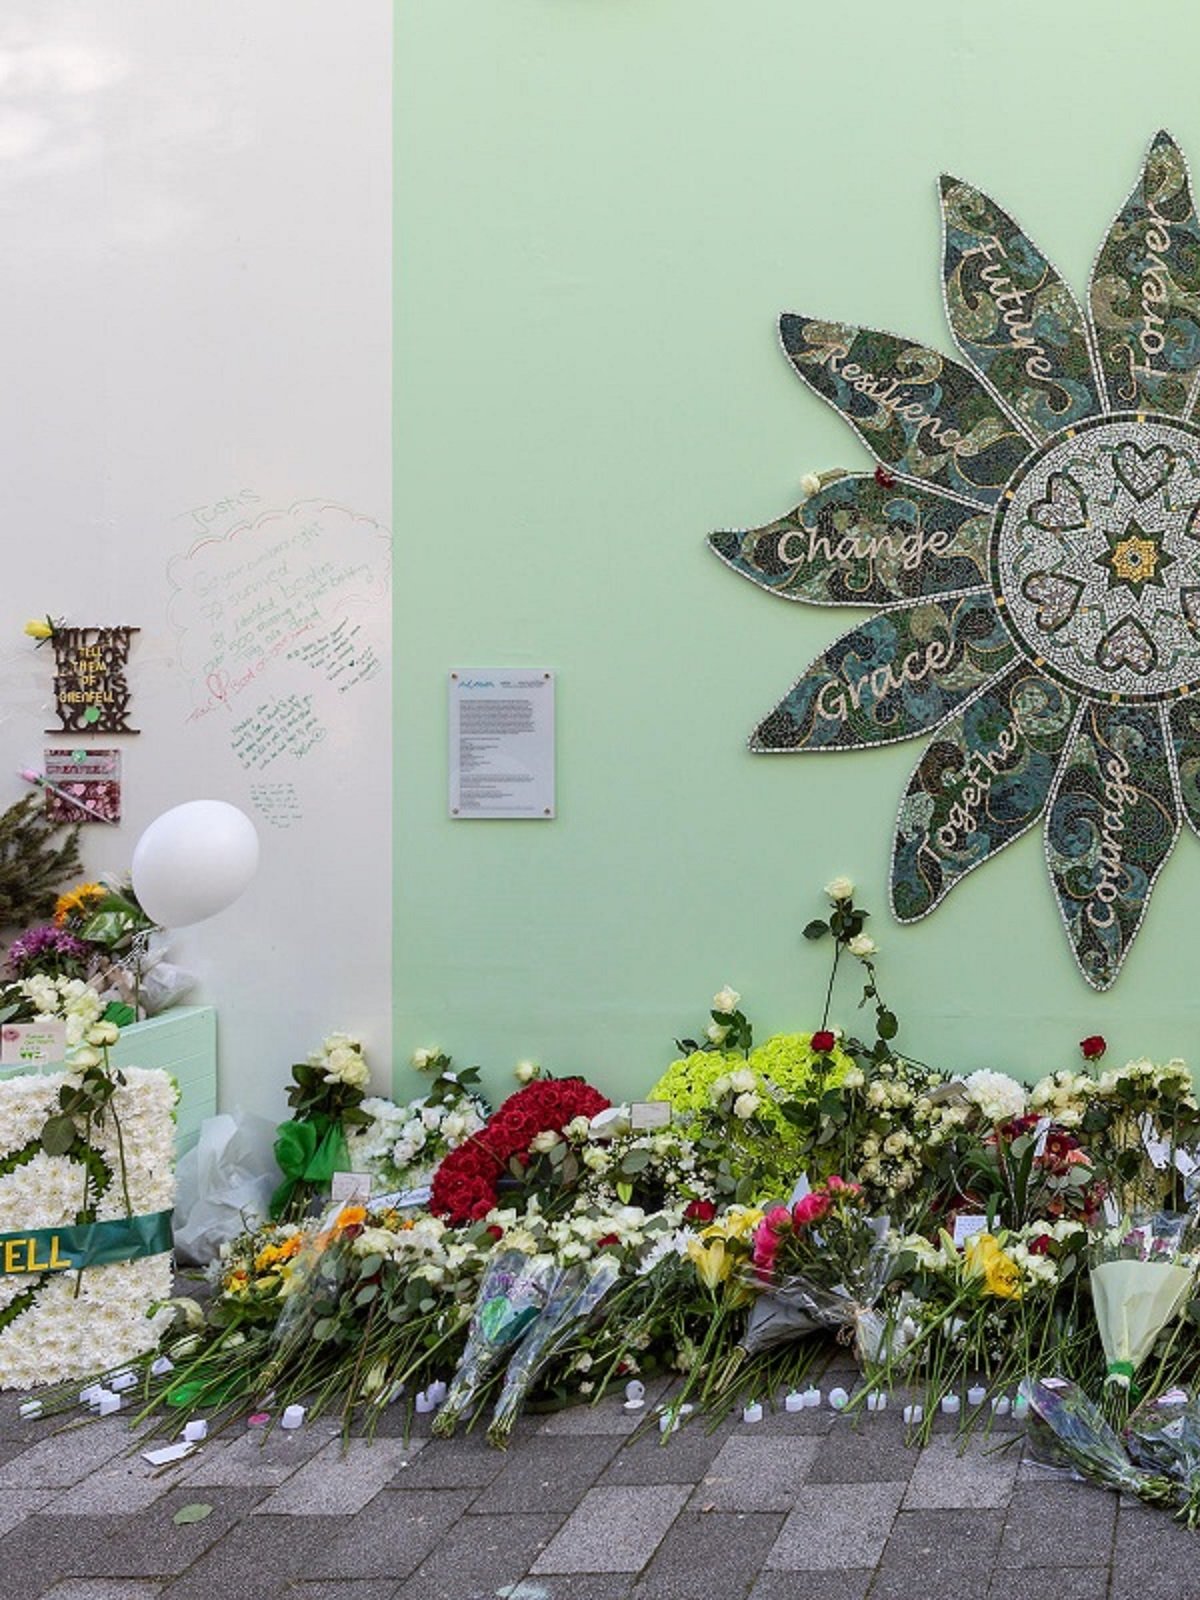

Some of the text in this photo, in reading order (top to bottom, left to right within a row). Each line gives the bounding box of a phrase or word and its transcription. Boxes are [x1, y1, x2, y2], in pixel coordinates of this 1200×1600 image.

[962, 236, 1053, 380] Future
[1122, 199, 1172, 385] Forever
[818, 350, 979, 457] Resilience
[777, 527, 951, 570] Change
[73, 660, 107, 672] THEM
[79, 646, 102, 657] TELL
[82, 674, 97, 687] OF
[816, 640, 955, 721] Grace
[918, 721, 1021, 861] Together
[1087, 753, 1140, 929] Courage
[0, 1236, 72, 1273] ELL
